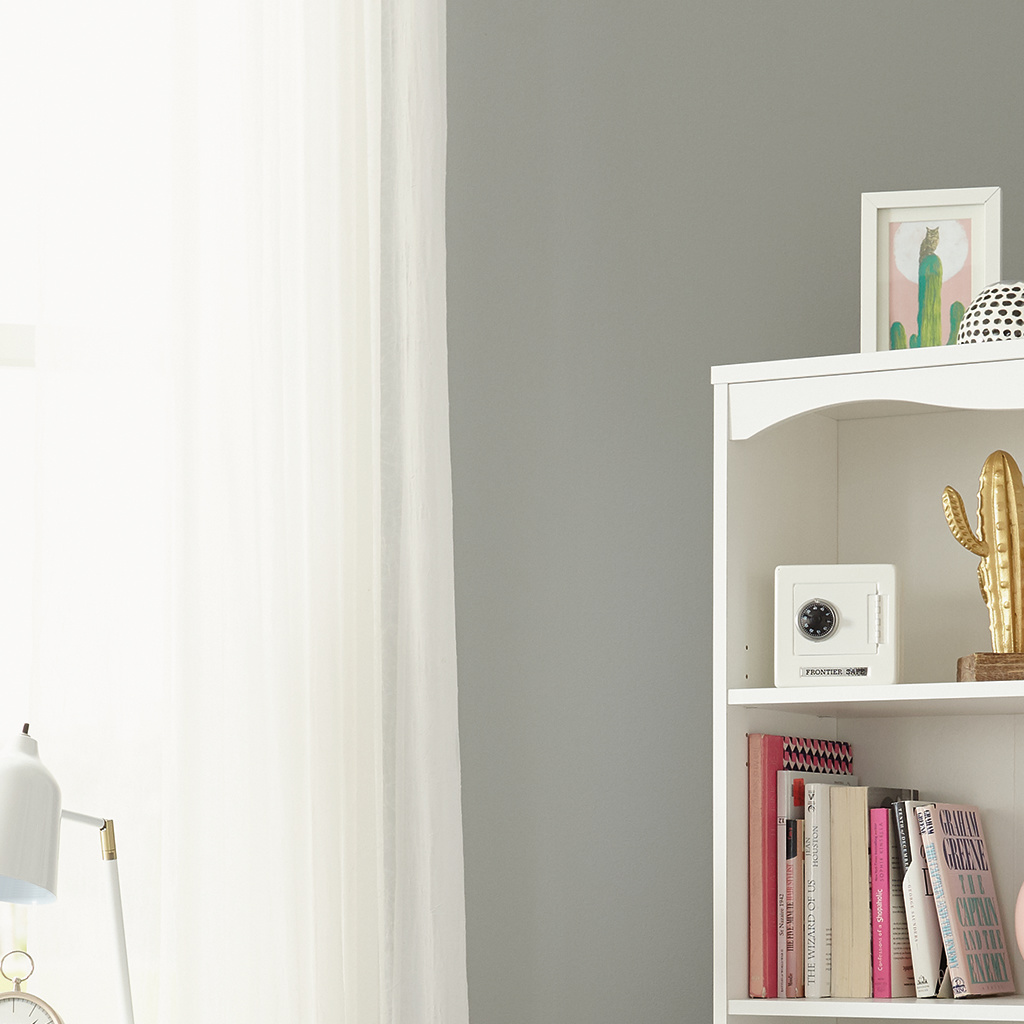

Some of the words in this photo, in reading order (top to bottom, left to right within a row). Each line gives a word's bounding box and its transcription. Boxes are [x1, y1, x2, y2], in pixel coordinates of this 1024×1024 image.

[939, 809, 980, 838] GRAHAM
[926, 843, 937, 862] THE
[943, 837, 988, 871] GREENE
[807, 879, 816, 893] US
[958, 874, 985, 895] THE
[807, 895, 816, 911] OF
[875, 888, 884, 923] Shopaholic
[956, 896, 999, 927] CAPTAIN
[807, 913, 816, 960] WIZARD
[963, 930, 982, 951] AND
[982, 929, 1004, 950] THE
[876, 937, 884, 971] Confessions
[965, 953, 1010, 984] ENEMY
[807, 963, 816, 986] THE
